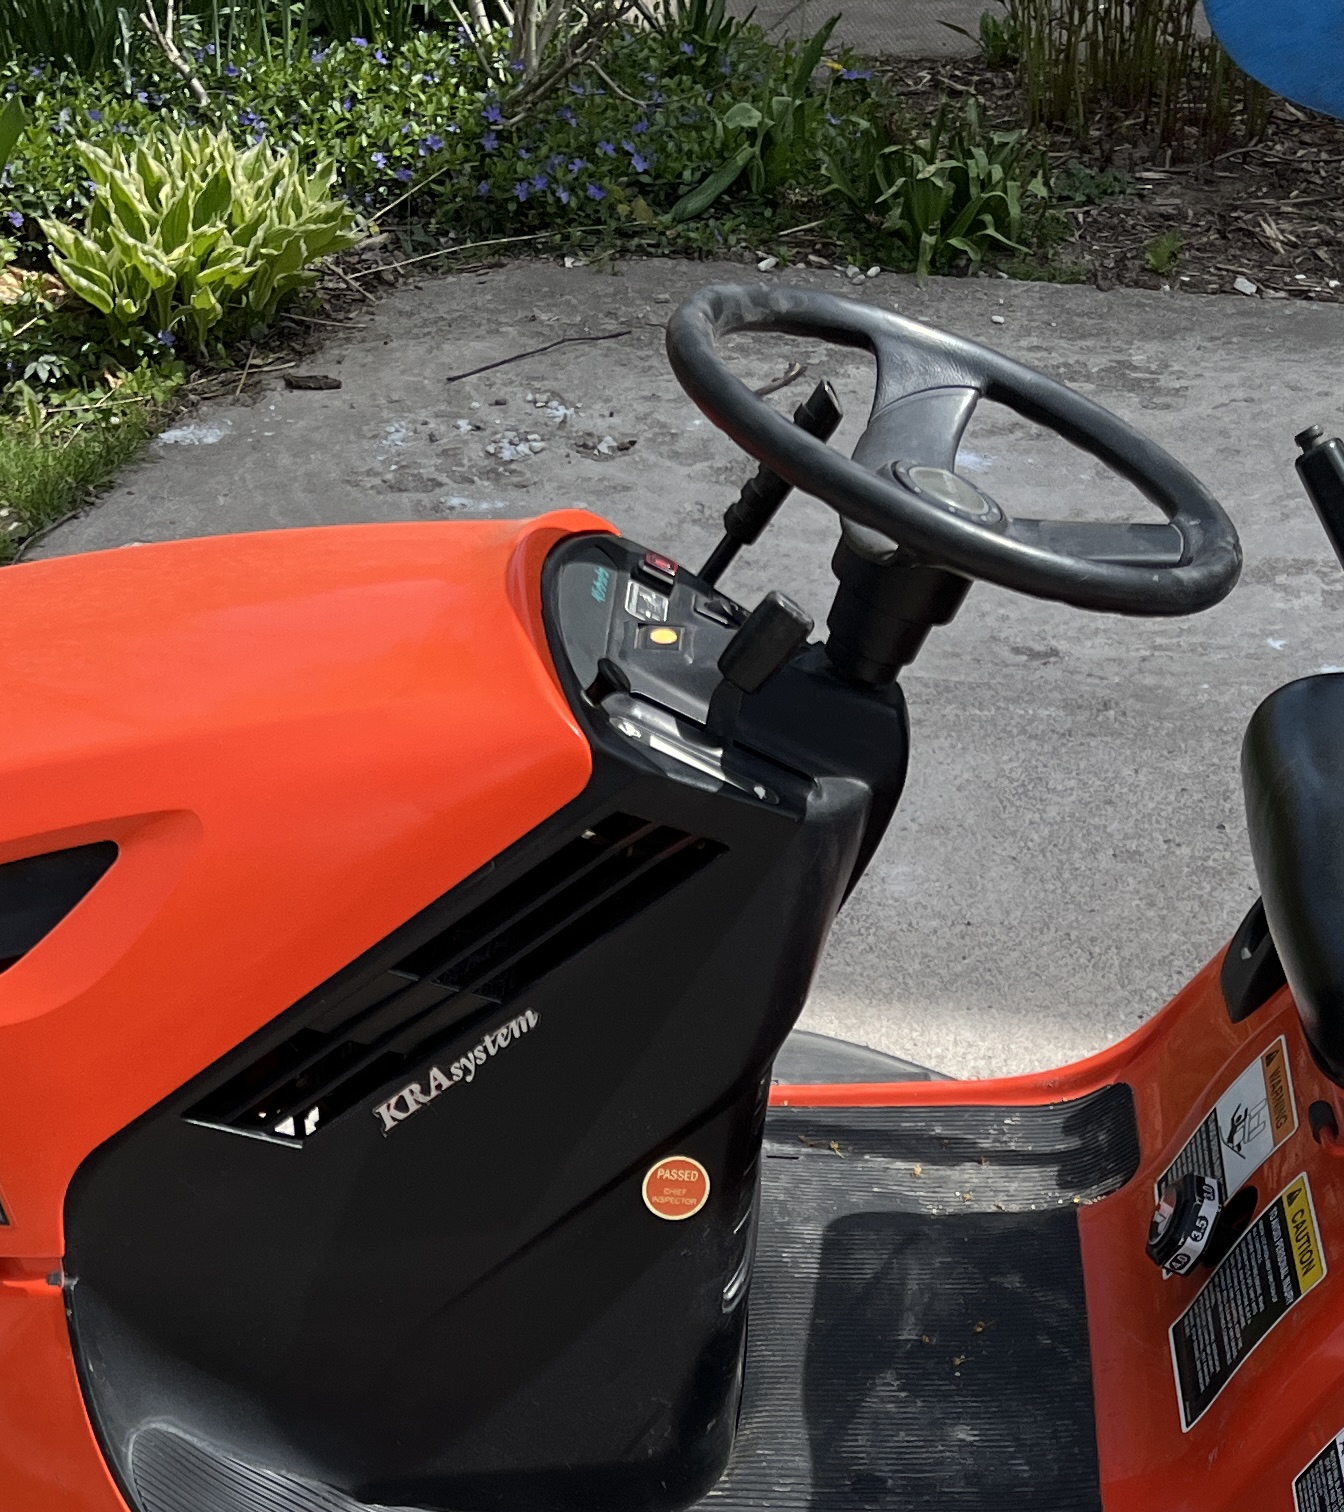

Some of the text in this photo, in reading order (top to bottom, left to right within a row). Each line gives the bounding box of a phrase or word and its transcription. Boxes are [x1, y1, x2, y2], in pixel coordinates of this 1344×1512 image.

[1268, 1064, 1288, 1132] WARNING
[656, 1168, 699, 1182] PASSED
[651, 1195, 697, 1206] INSPECTOR
[1202, 1184, 1214, 1201] 3.0
[1190, 1217, 1208, 1241] 3.5
[1290, 1207, 1315, 1278] CAUTION
[1171, 1253, 1188, 1269] 4.0
